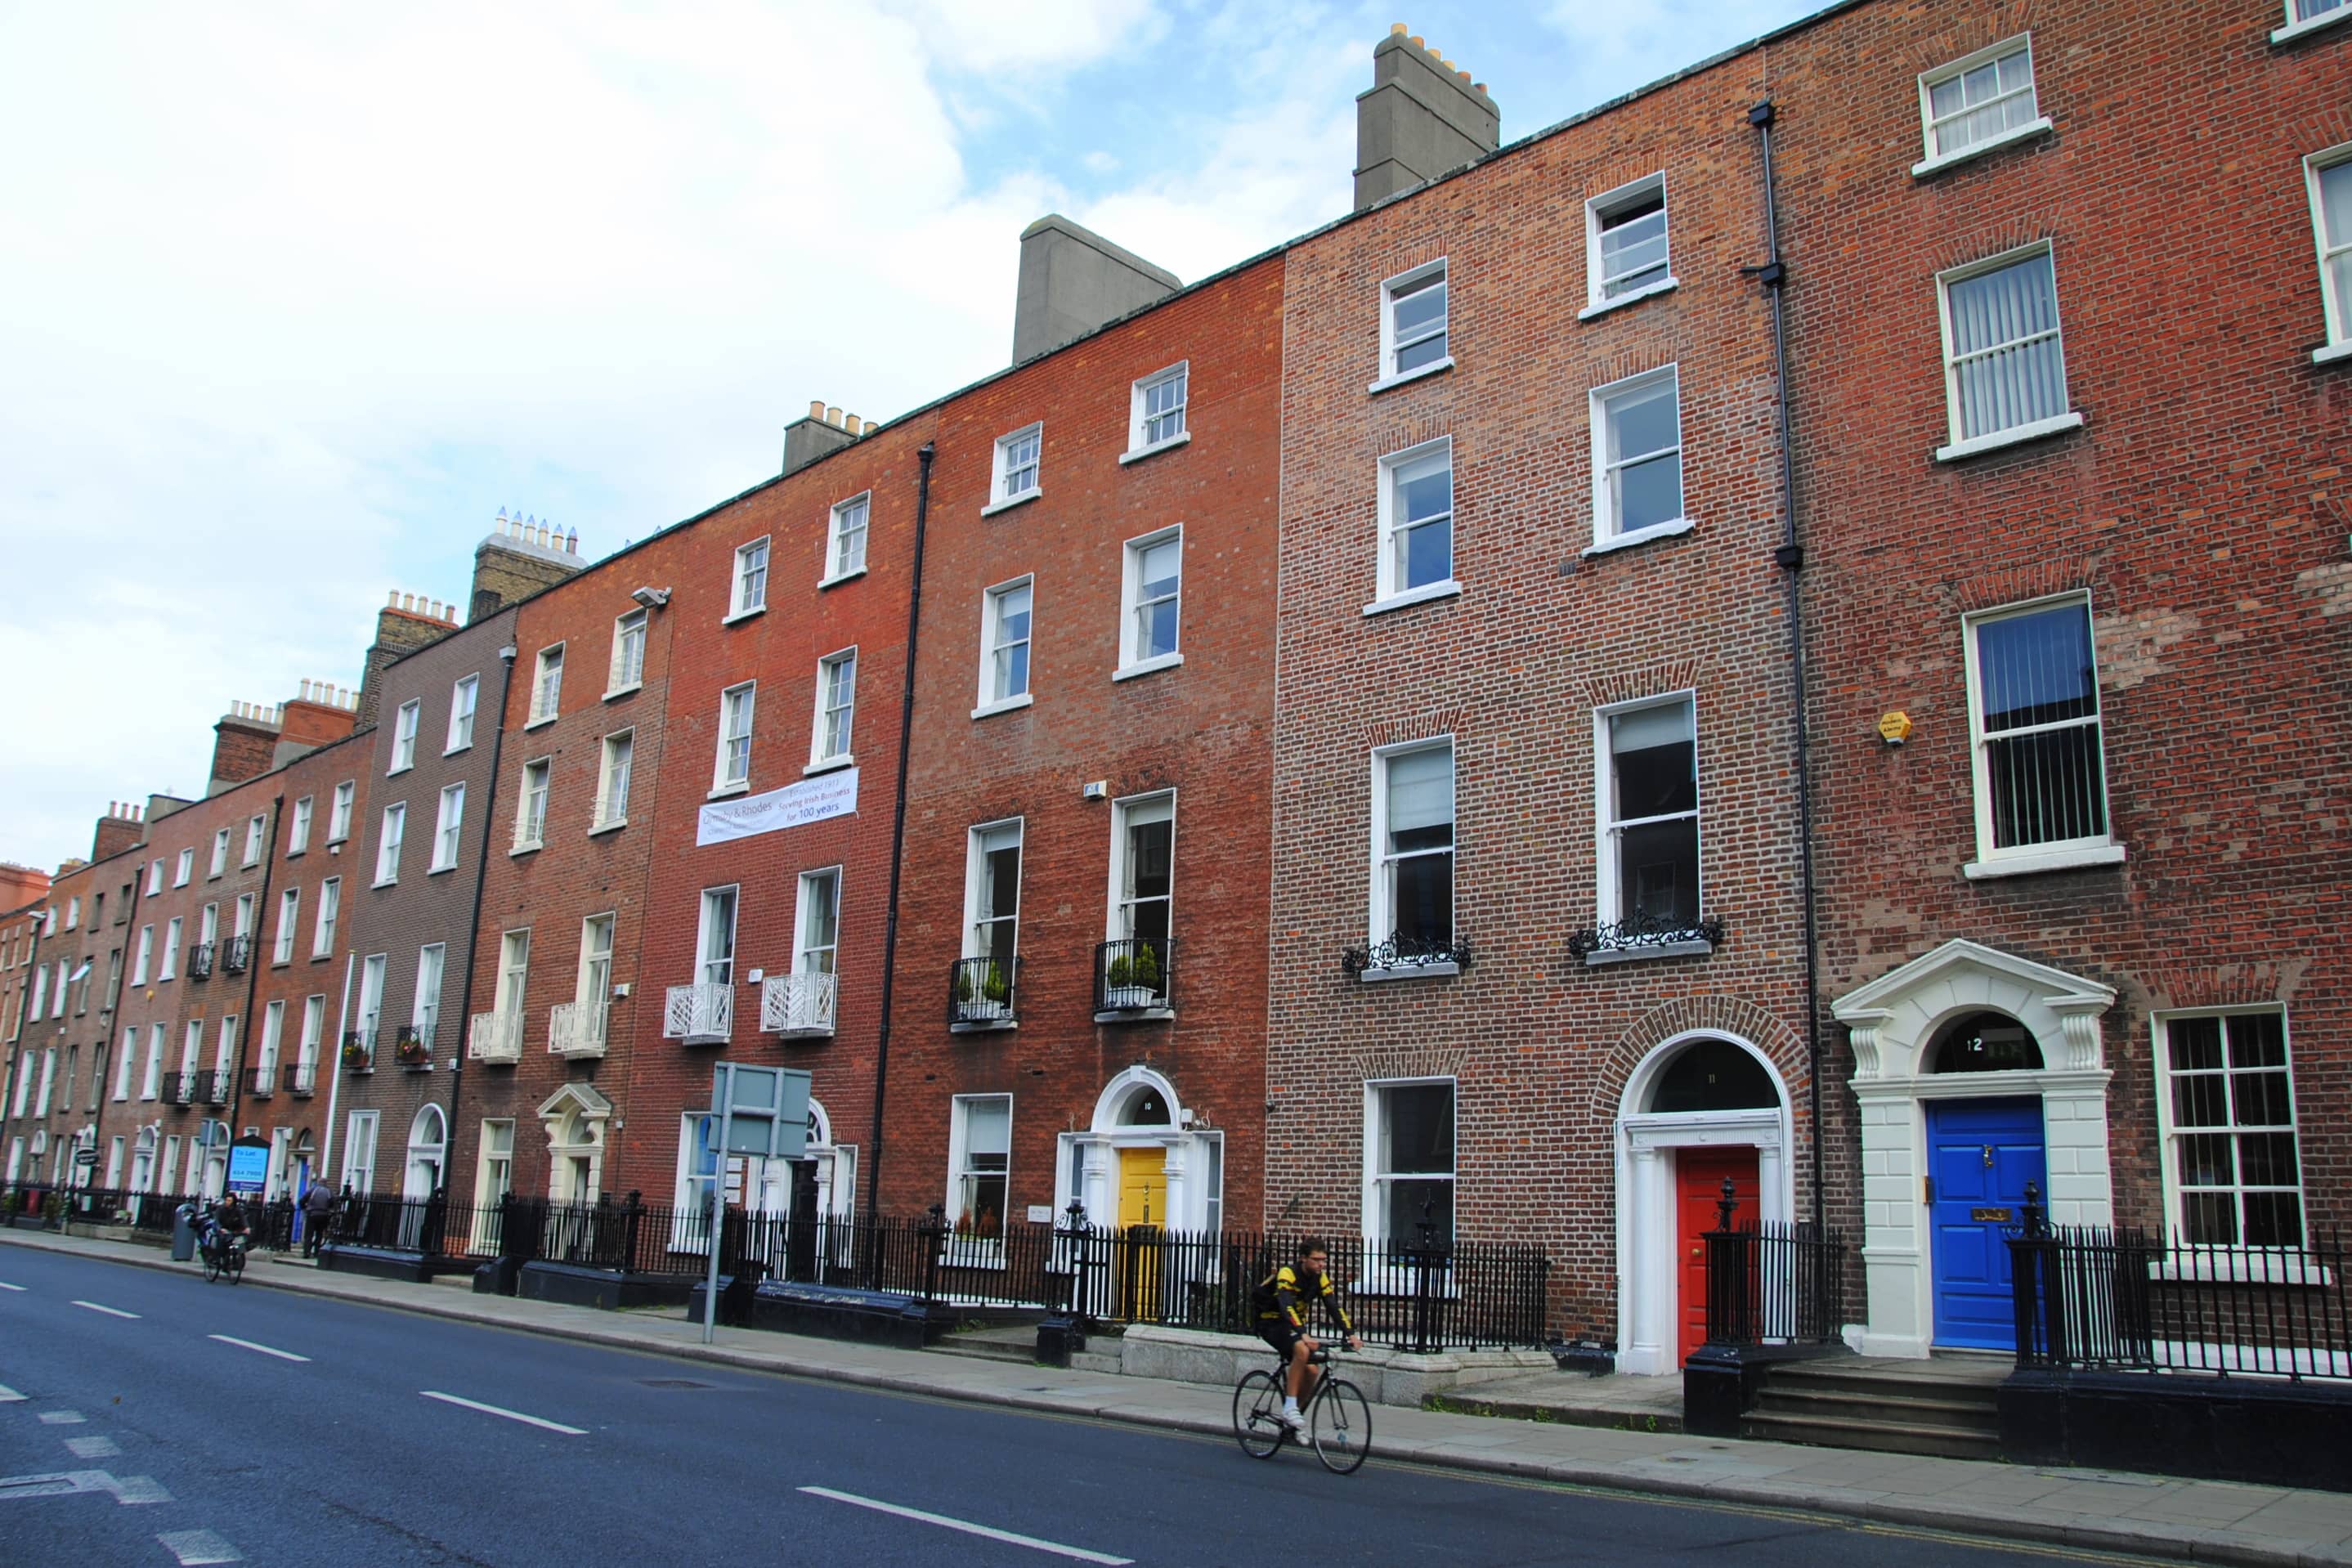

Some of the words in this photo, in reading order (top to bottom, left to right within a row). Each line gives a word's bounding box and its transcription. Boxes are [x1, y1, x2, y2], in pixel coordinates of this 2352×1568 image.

[778, 799, 803, 810] Serving
[804, 793, 819, 804] Irish
[821, 787, 851, 800] Business
[733, 807, 741, 818] &
[741, 801, 773, 817] Rhodes
[786, 812, 798, 822] for
[799, 806, 814, 818] 100
[817, 803, 840, 817] years
[1966, 1037, 1982, 1051] 12
[1709, 1073, 1716, 1085] 11
[1145, 1102, 1152, 1111] 10
